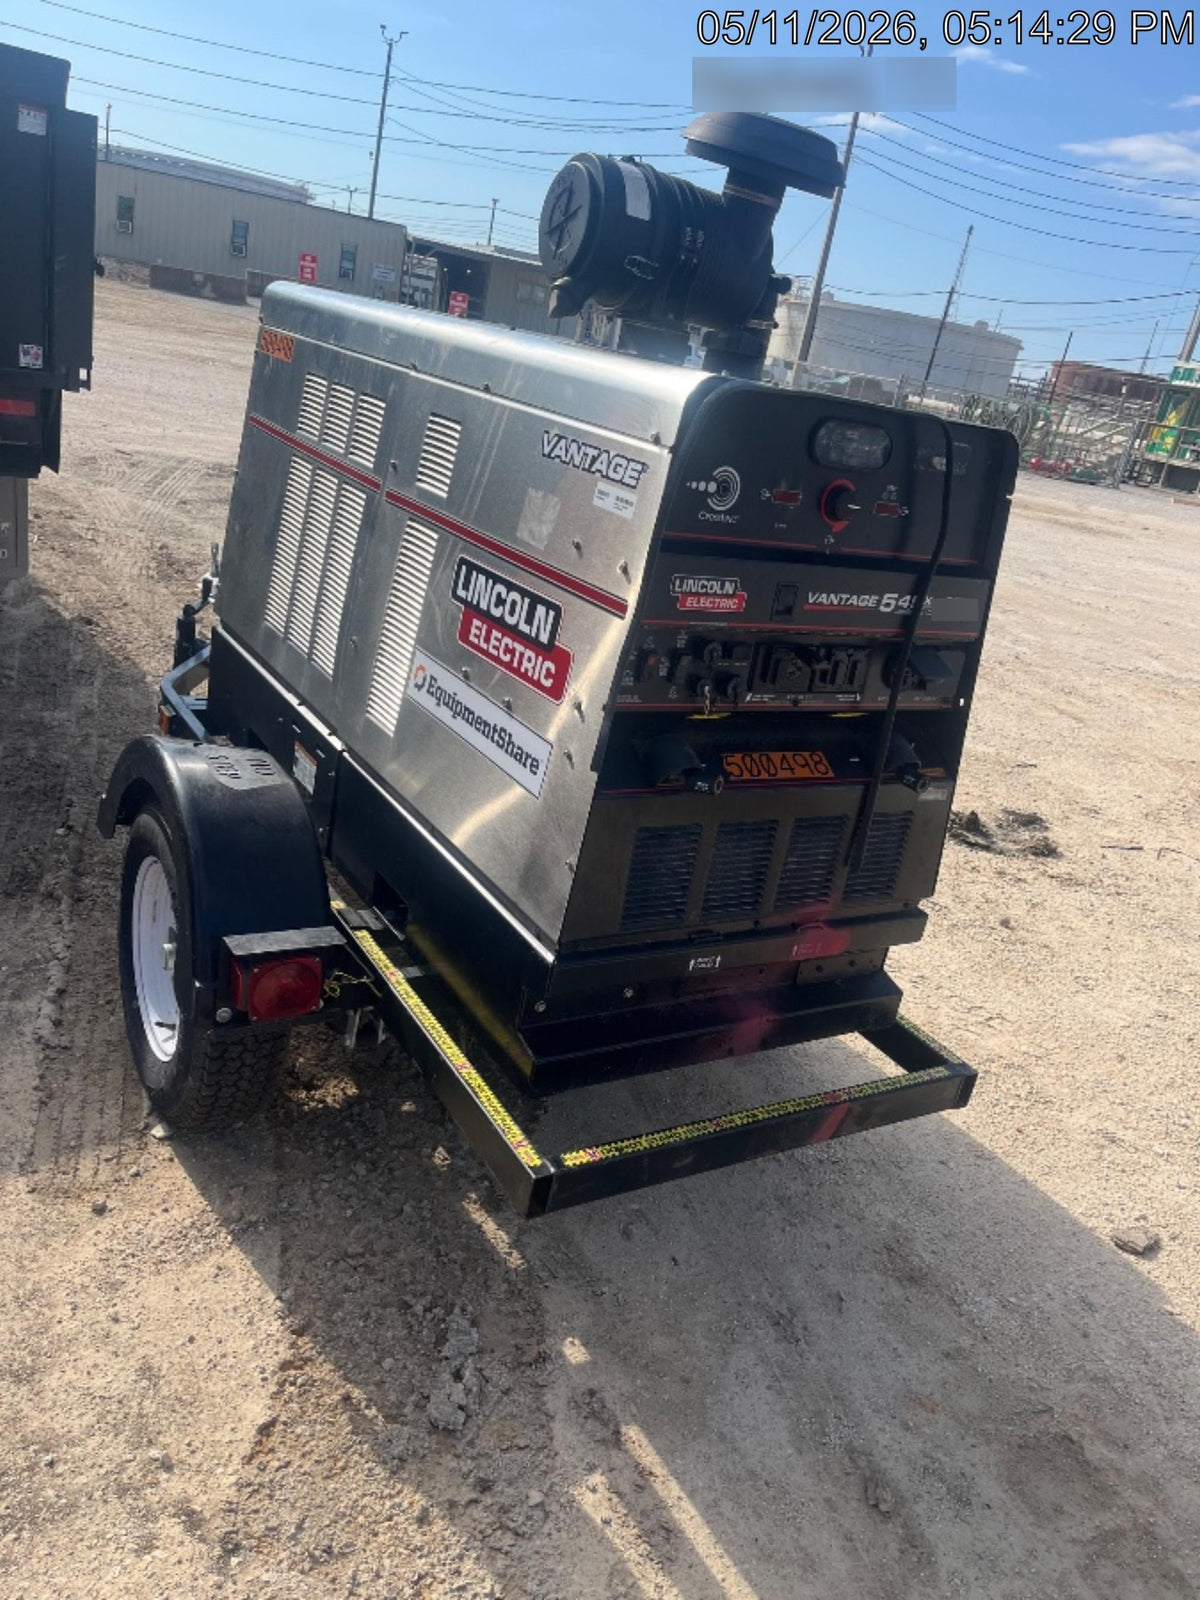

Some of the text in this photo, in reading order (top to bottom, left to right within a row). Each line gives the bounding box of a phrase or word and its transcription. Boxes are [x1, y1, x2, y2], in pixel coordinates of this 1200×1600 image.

[541, 430, 645, 489] VANTAGE
[455, 563, 556, 645] LINCOLN
[674, 578, 736, 595] LINCOLN
[685, 595, 739, 610] ELECTRIC
[808, 591, 880, 608] VANTAGE
[468, 619, 556, 690] ELECTRIC
[425, 671, 542, 778] EquipmentShare
[723, 751, 831, 778] 500498
